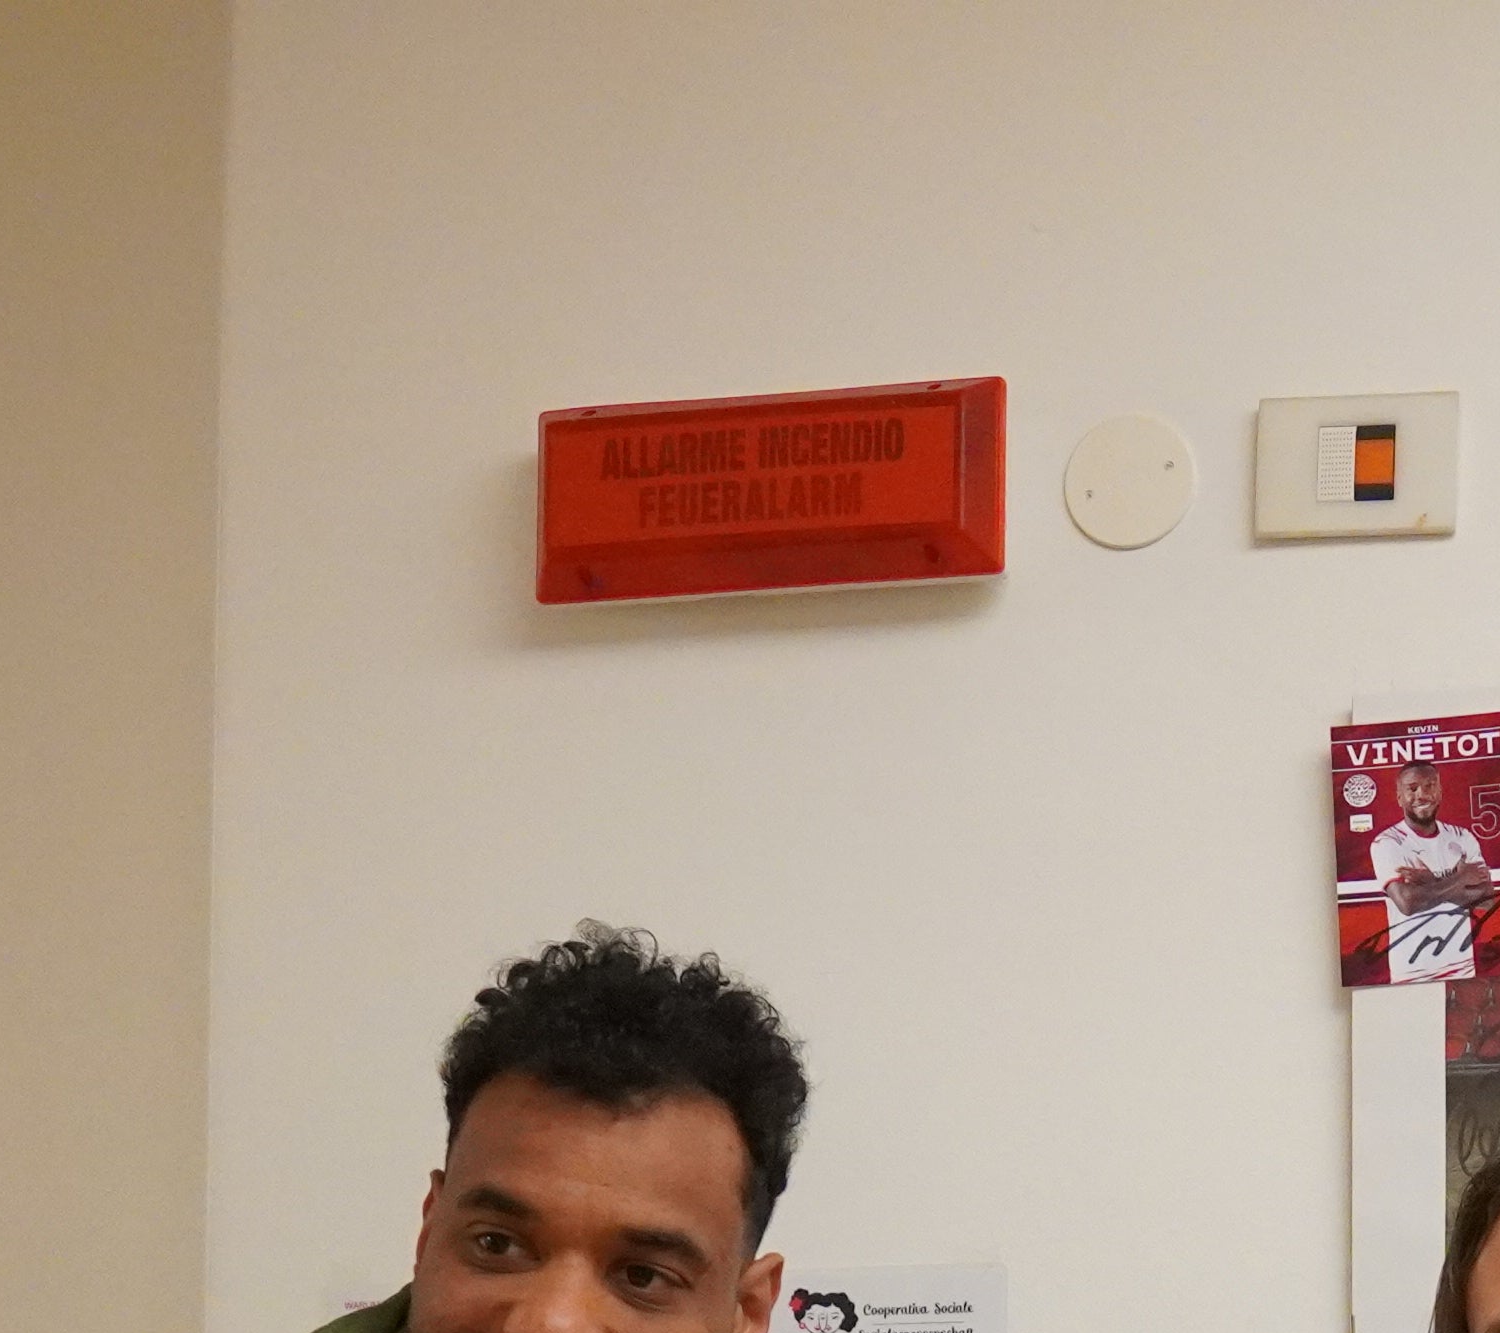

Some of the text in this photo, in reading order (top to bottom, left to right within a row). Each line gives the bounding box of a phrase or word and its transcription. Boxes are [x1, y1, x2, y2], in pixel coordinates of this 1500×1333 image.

[601, 415, 905, 481] ALLARME INCENDIO
[638, 471, 864, 529] FEUERALARM
[1407, 724, 1439, 735] KEVIN
[1346, 731, 1500, 766] VINETOT
[863, 1301, 974, 1318] Cooperativa Sociale
